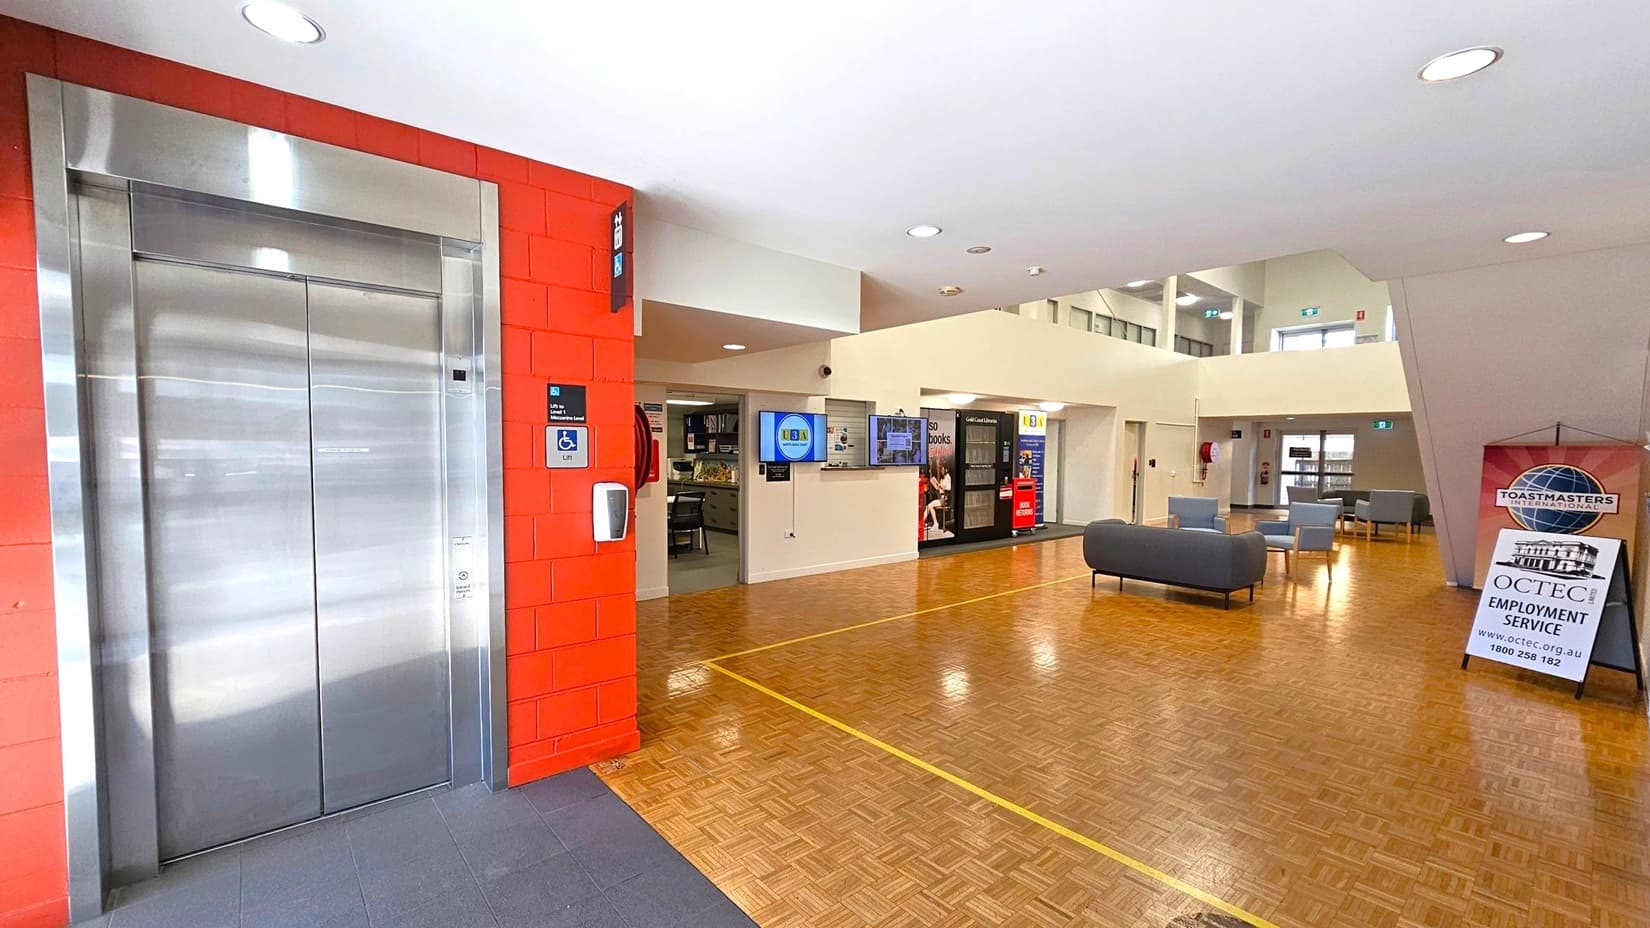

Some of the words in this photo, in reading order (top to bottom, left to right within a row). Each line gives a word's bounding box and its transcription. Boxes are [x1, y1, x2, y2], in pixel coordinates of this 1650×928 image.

[781, 429, 808, 441] U3A
[928, 422, 938, 431] so
[1500, 491, 1614, 505] TOASTMASTERS
[1510, 500, 1600, 511] INTERNATIONAL
[1493, 574, 1588, 603] OCTEC
[1488, 596, 1589, 625] EMPLOYMENT
[1503, 614, 1563, 636] SERVICE
[1478, 629, 1582, 658] www.octec.org.au
[1490, 644, 1515, 656] 1800
[1516, 650, 1537, 661] 258
[1541, 656, 1561, 667] 182
